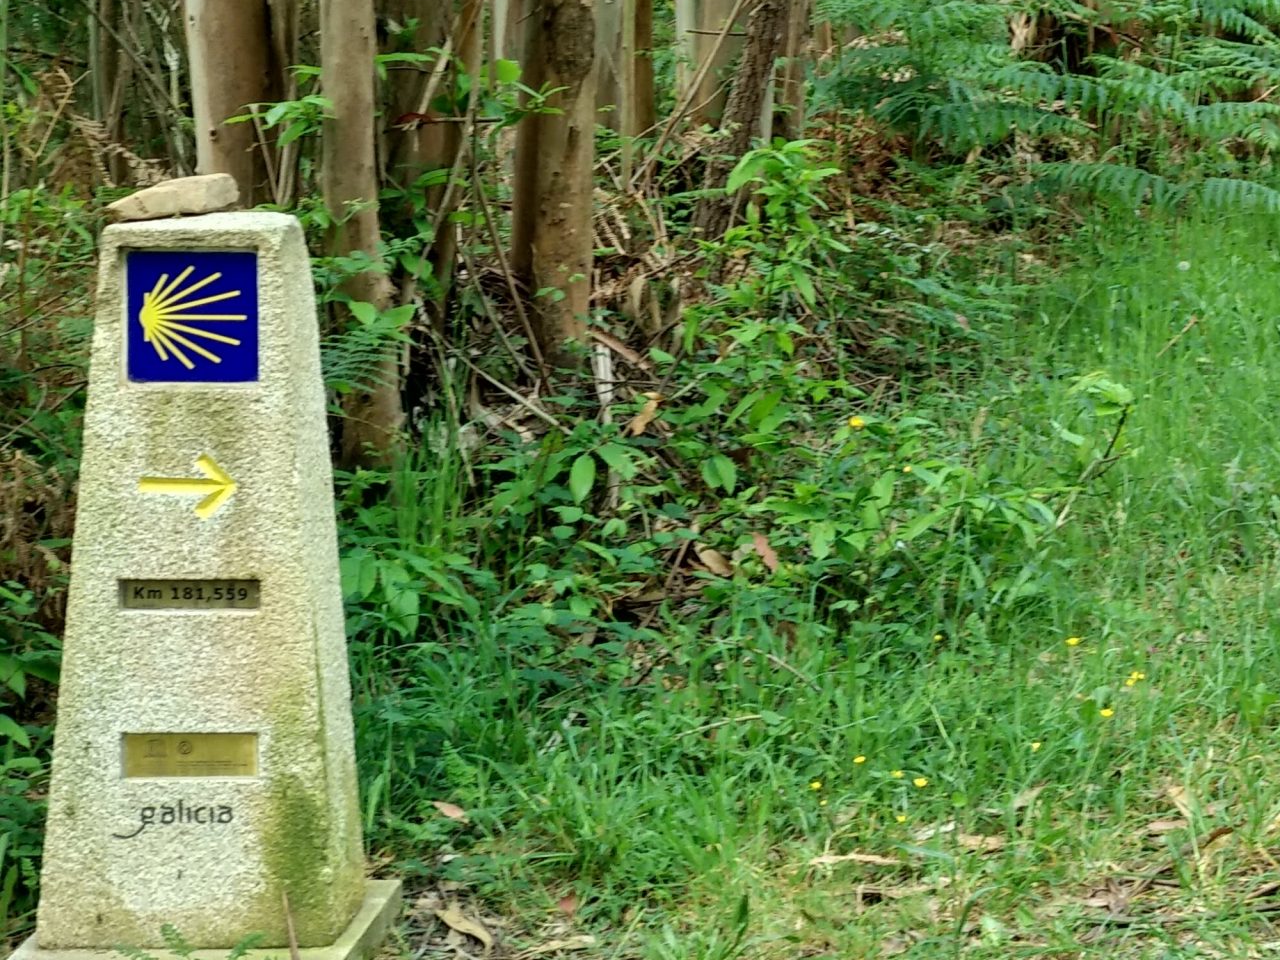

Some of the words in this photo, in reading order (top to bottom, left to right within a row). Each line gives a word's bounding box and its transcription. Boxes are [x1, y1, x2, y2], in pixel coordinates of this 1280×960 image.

[133, 586, 162, 600] Km
[171, 586, 248, 603] 181,559
[111, 799, 234, 839] galicia
